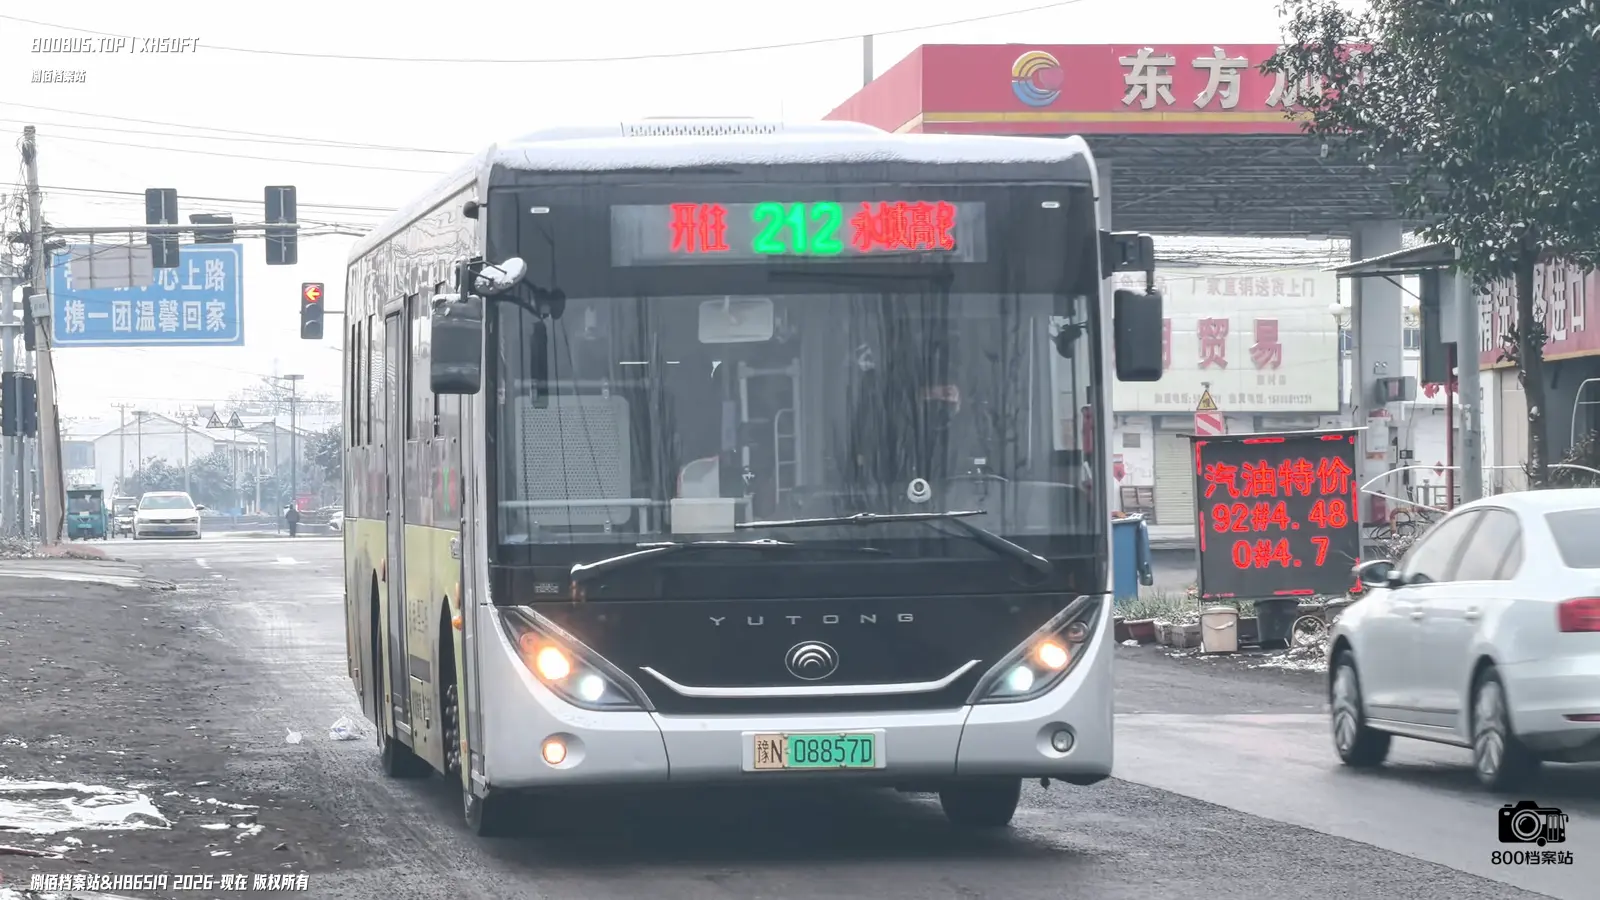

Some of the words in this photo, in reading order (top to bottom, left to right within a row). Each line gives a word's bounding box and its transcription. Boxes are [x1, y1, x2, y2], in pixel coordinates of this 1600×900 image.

[669, 202, 728, 253] 开往
[752, 201, 843, 254] 212
[1190, 277, 1316, 298] 厂家直销送货上门
[63, 298, 227, 334] 携一团温馨回家
[1204, 456, 1352, 498] 汽油特价
[709, 613, 914, 626] YUTONG
